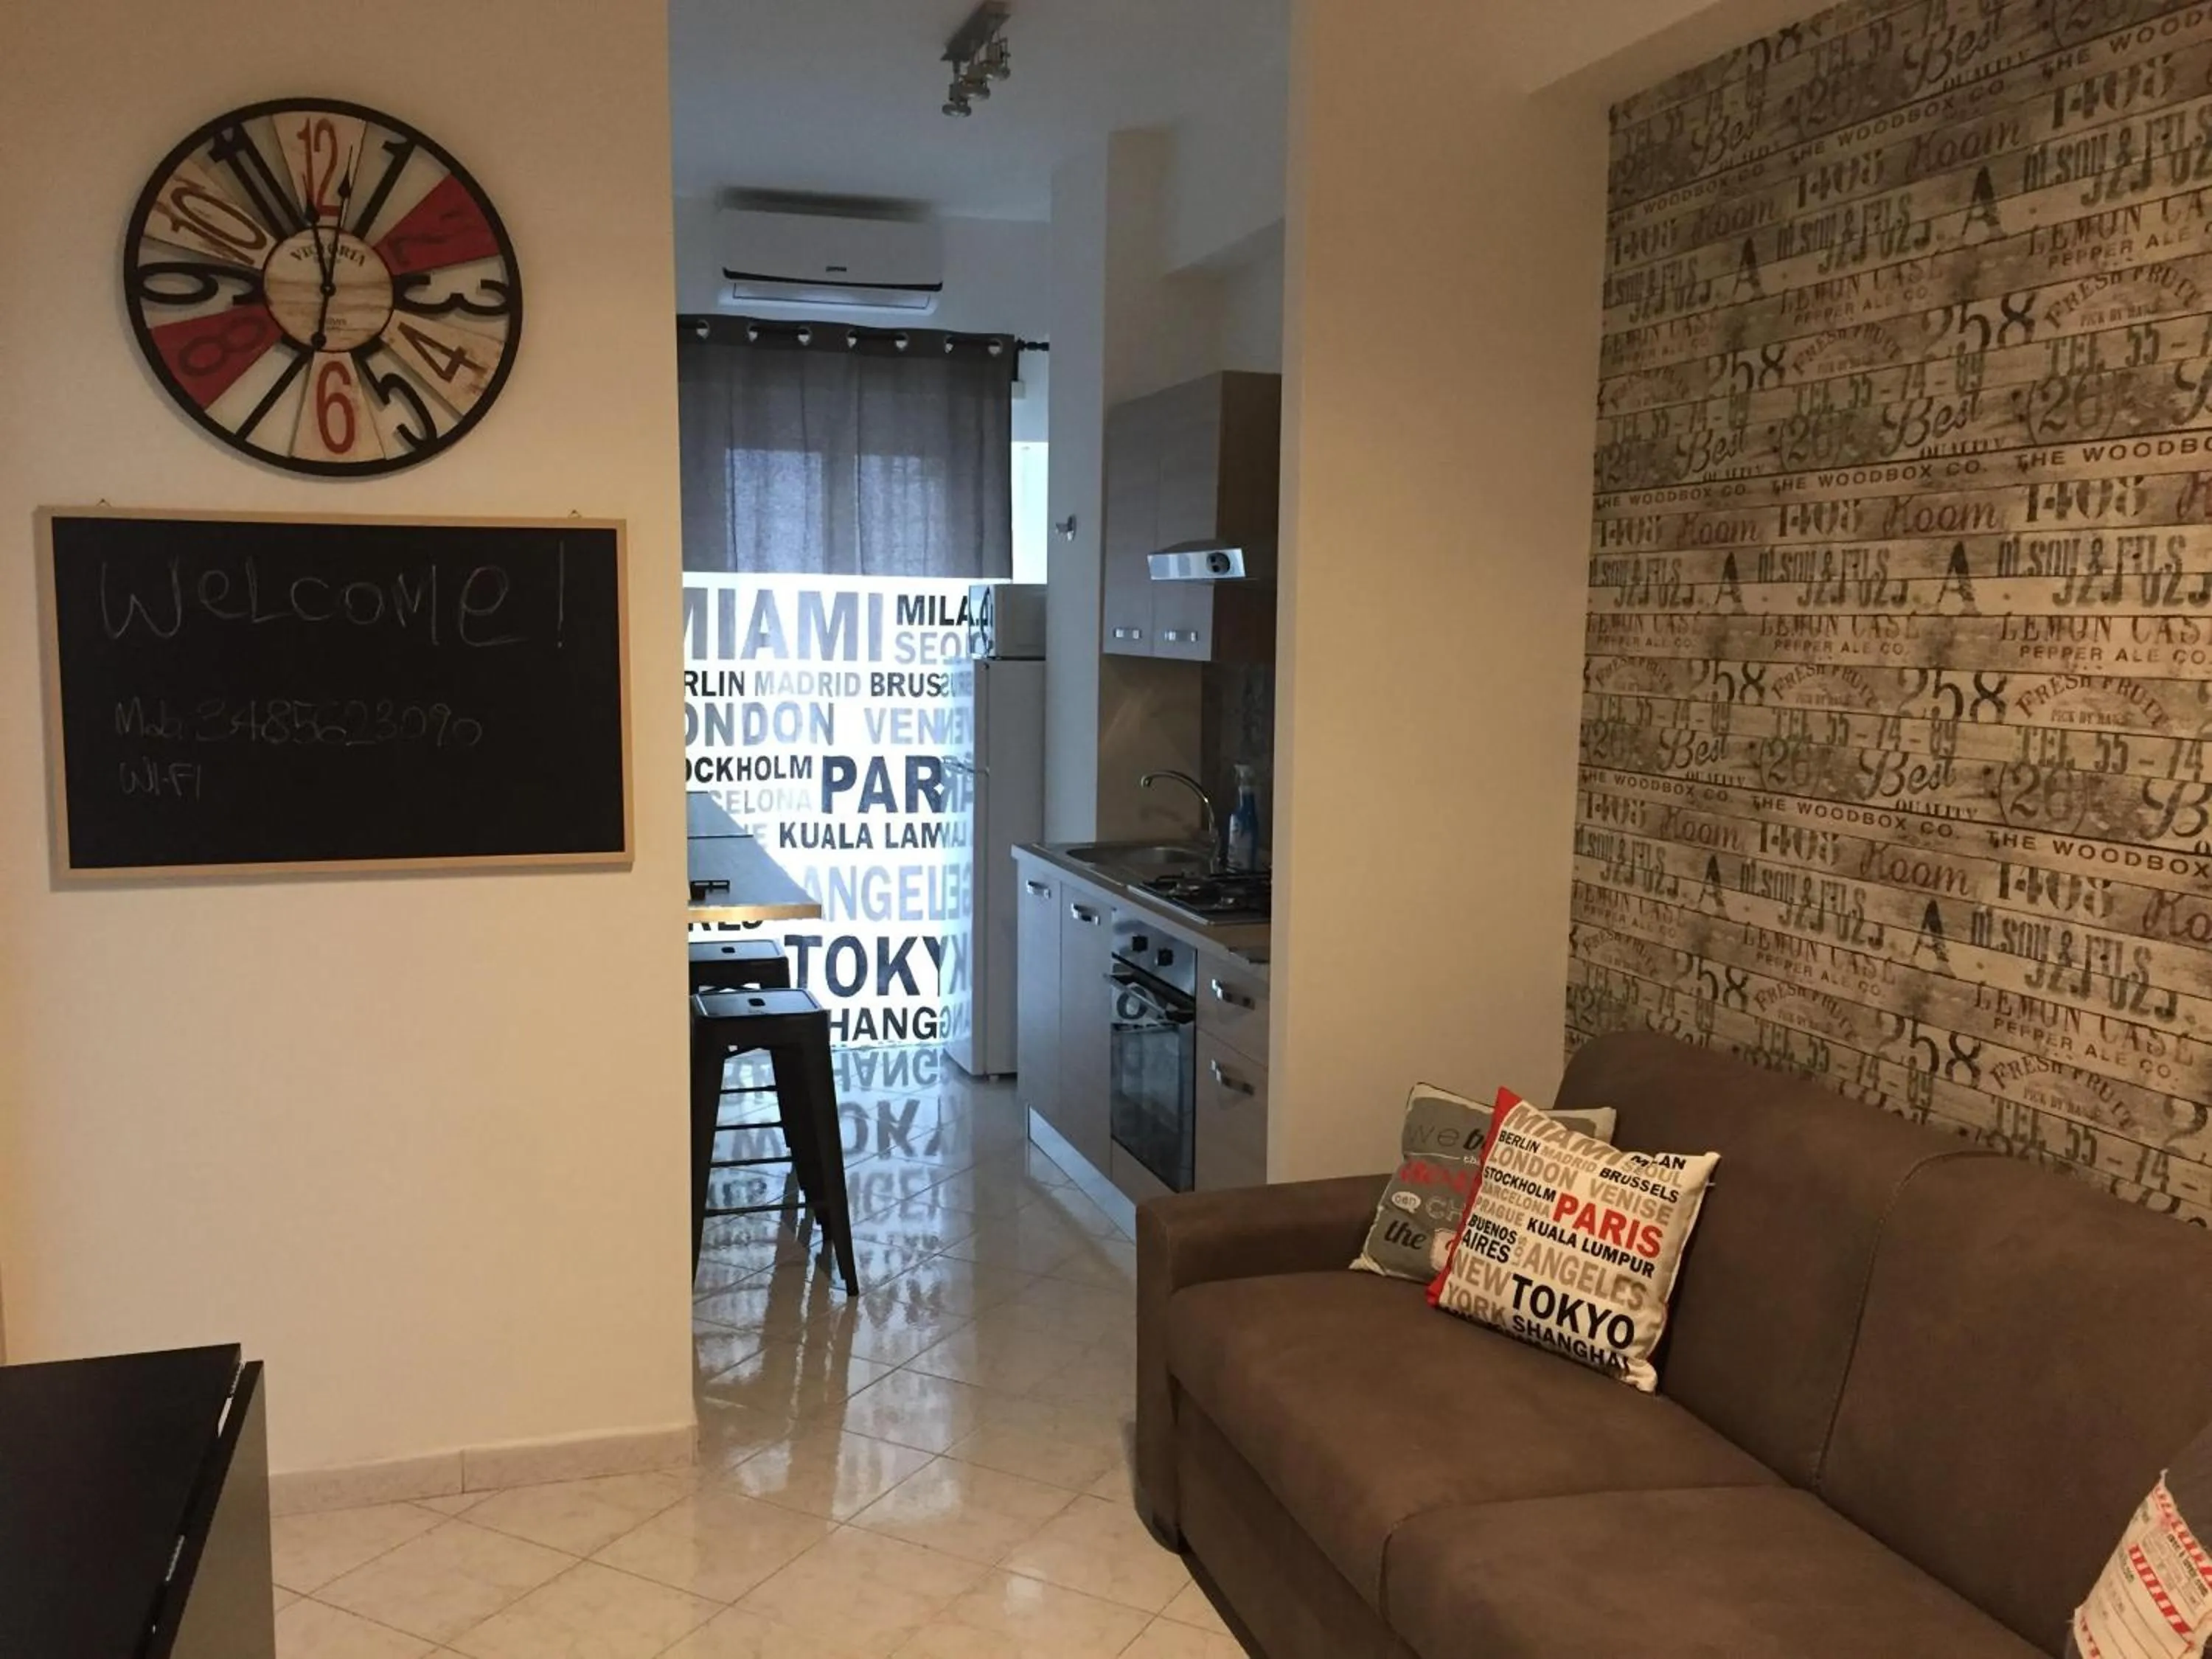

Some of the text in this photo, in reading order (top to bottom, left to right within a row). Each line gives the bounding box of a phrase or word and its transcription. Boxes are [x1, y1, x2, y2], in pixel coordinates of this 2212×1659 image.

[2040, 7, 2212, 80] THE WOOD
[1838, 94, 1957, 148] WOODBOX
[297, 118, 339, 216] 12
[354, 139, 417, 240] 1
[170, 186, 268, 265] 10
[1959, 166, 2006, 246] A
[290, 243, 366, 268] VICORIA
[387, 205, 465, 266] 2
[2045, 224, 2190, 271] PEPPER ALE
[139, 262, 265, 305] 9
[1731, 236, 1765, 302] A
[394, 274, 512, 316] 3
[2042, 269, 2121, 328] FRESH
[179, 315, 268, 377] 8
[1917, 288, 2035, 361] 258
[398, 321, 488, 382] 4
[316, 361, 355, 454] 6
[350, 337, 437, 449] 5
[1770, 476, 1806, 493] THE
[1818, 464, 1933, 487] WOODBOX
[2013, 450, 2065, 471] THE
[1630, 486, 1713, 505] WOODBOX
[1715, 552, 1747, 613] A
[1935, 541, 1980, 613] A
[1840, 641, 1871, 653] ALE
[1997, 616, 2212, 645] LEMON CAS
[2018, 645, 2101, 661] PEPPER
[2113, 647, 2157, 662] ALE
[754, 670, 861, 698] MADRID
[1772, 664, 1825, 700] FRESH
[1894, 668, 2008, 723] 258
[2015, 674, 2091, 717] FRESH
[1616, 776, 1697, 799] WOODBOX
[1857, 746, 1957, 812] Best
[779, 822, 874, 849] KUALA
[1753, 796, 1787, 814] THE
[1799, 803, 1910, 832] WOODBOX
[1987, 830, 2037, 854] THE
[1699, 858, 1731, 920] A
[1912, 902, 1956, 977] A
[1671, 952, 1750, 1015] 258
[1873, 1011, 1983, 1091] 258
[1989, 1055, 2062, 1090] FRESH
[2084, 1042, 2126, 1067] ALE
[1498, 1130, 1540, 1153] BERLIN
[1540, 1146, 1598, 1174] MADRID
[1503, 1105, 1622, 1166] MIAMI
[1484, 1166, 1557, 1204] STOCKHOLM
[1489, 1145, 1579, 1192] LONDON
[1589, 1179, 1674, 1227] VENISE
[1599, 1167, 1680, 1204] BRUSSELS
[1385, 1220, 1427, 1251] the
[1468, 1214, 1517, 1246] BUENOS
[1475, 1196, 1526, 1228] PRAGUE
[1553, 1192, 1663, 1259] PARIS
[1461, 1228, 1512, 1264] AIRES
[1526, 1217, 1655, 1279] KUALA LUMPUR
[1453, 1249, 1512, 1297] NEW
[1522, 1242, 1647, 1311] ANGELES
[1447, 1281, 1506, 1326] YORK
[1512, 1273, 1635, 1350] TOKYO
